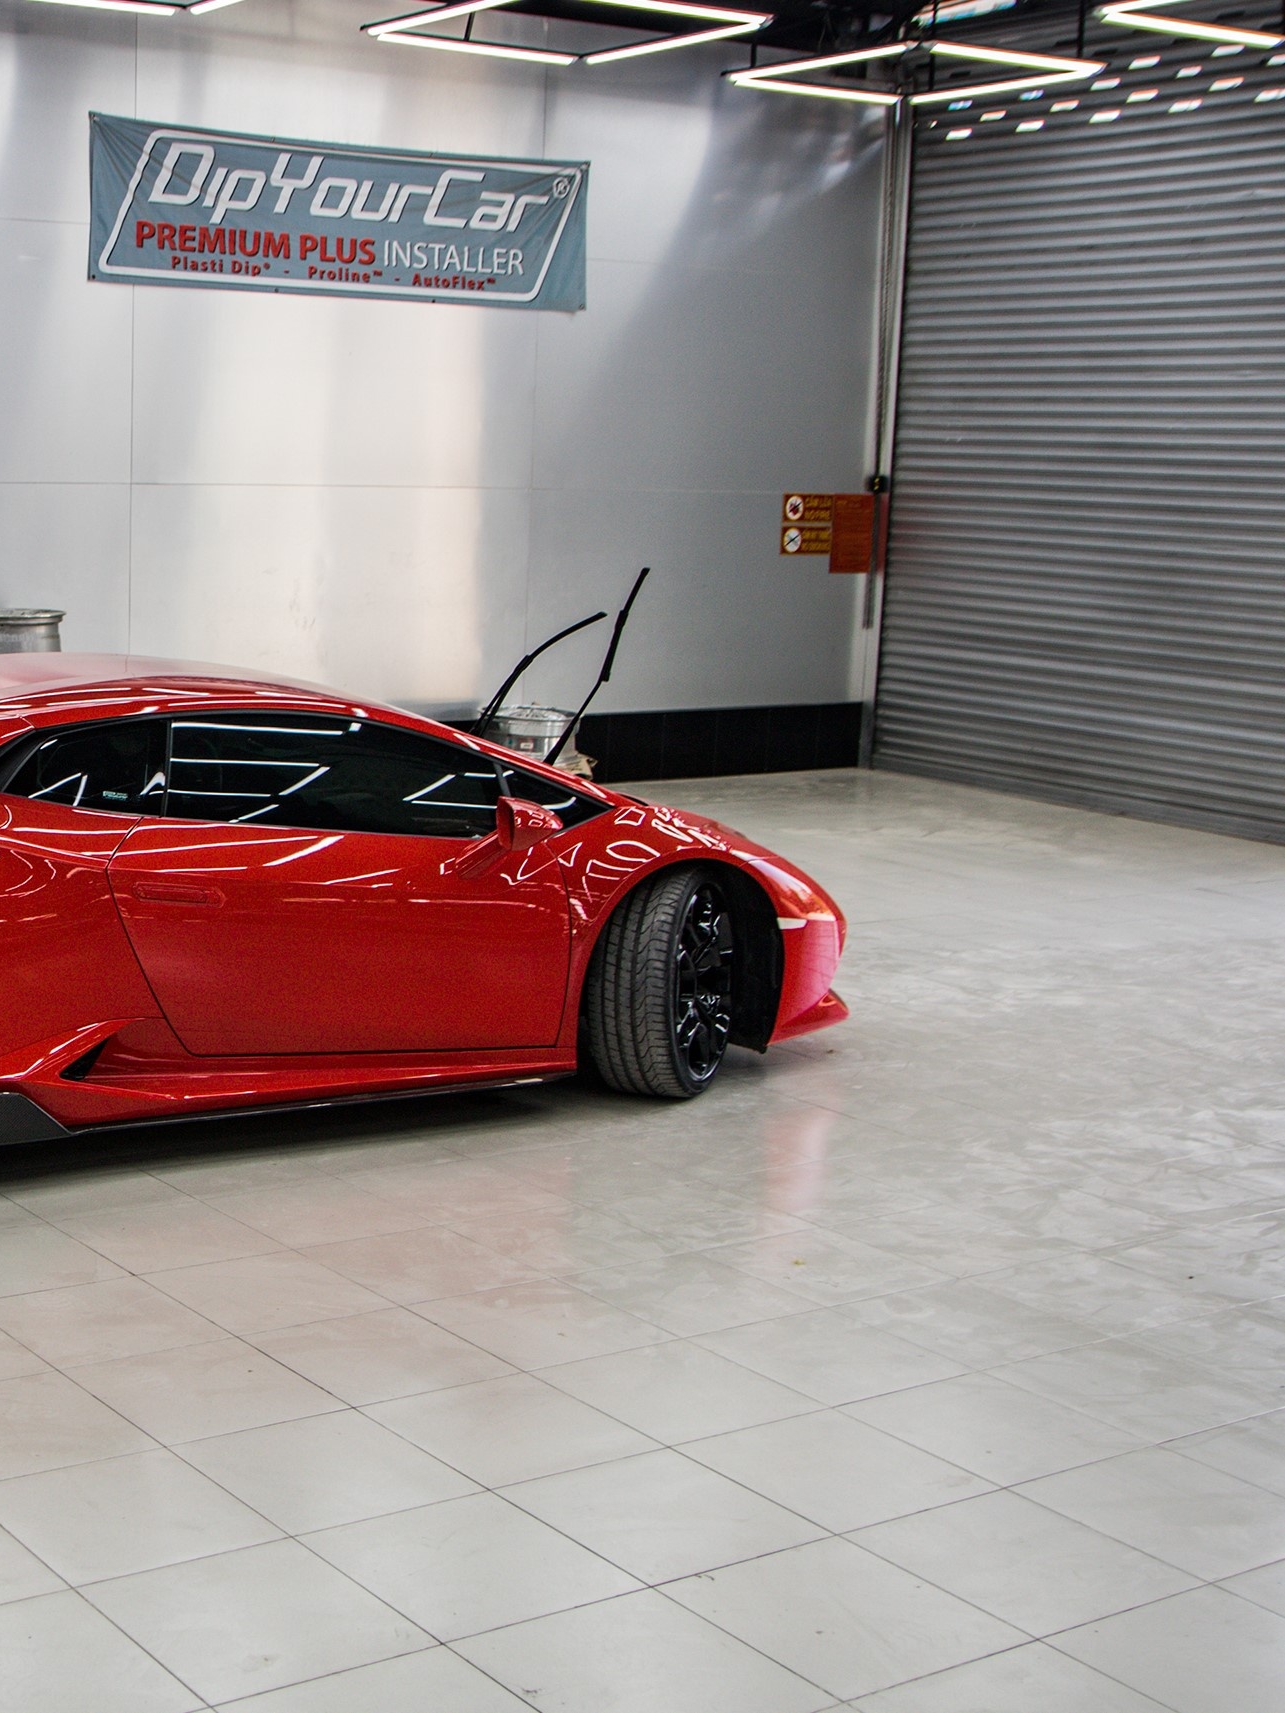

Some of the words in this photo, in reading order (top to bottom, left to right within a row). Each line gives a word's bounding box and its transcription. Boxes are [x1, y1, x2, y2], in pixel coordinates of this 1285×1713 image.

[135, 220, 291, 260] PREMIUM
[299, 233, 377, 266] PLUS
[383, 239, 525, 276] INSTALLER
[171, 255, 224, 273] Plasti
